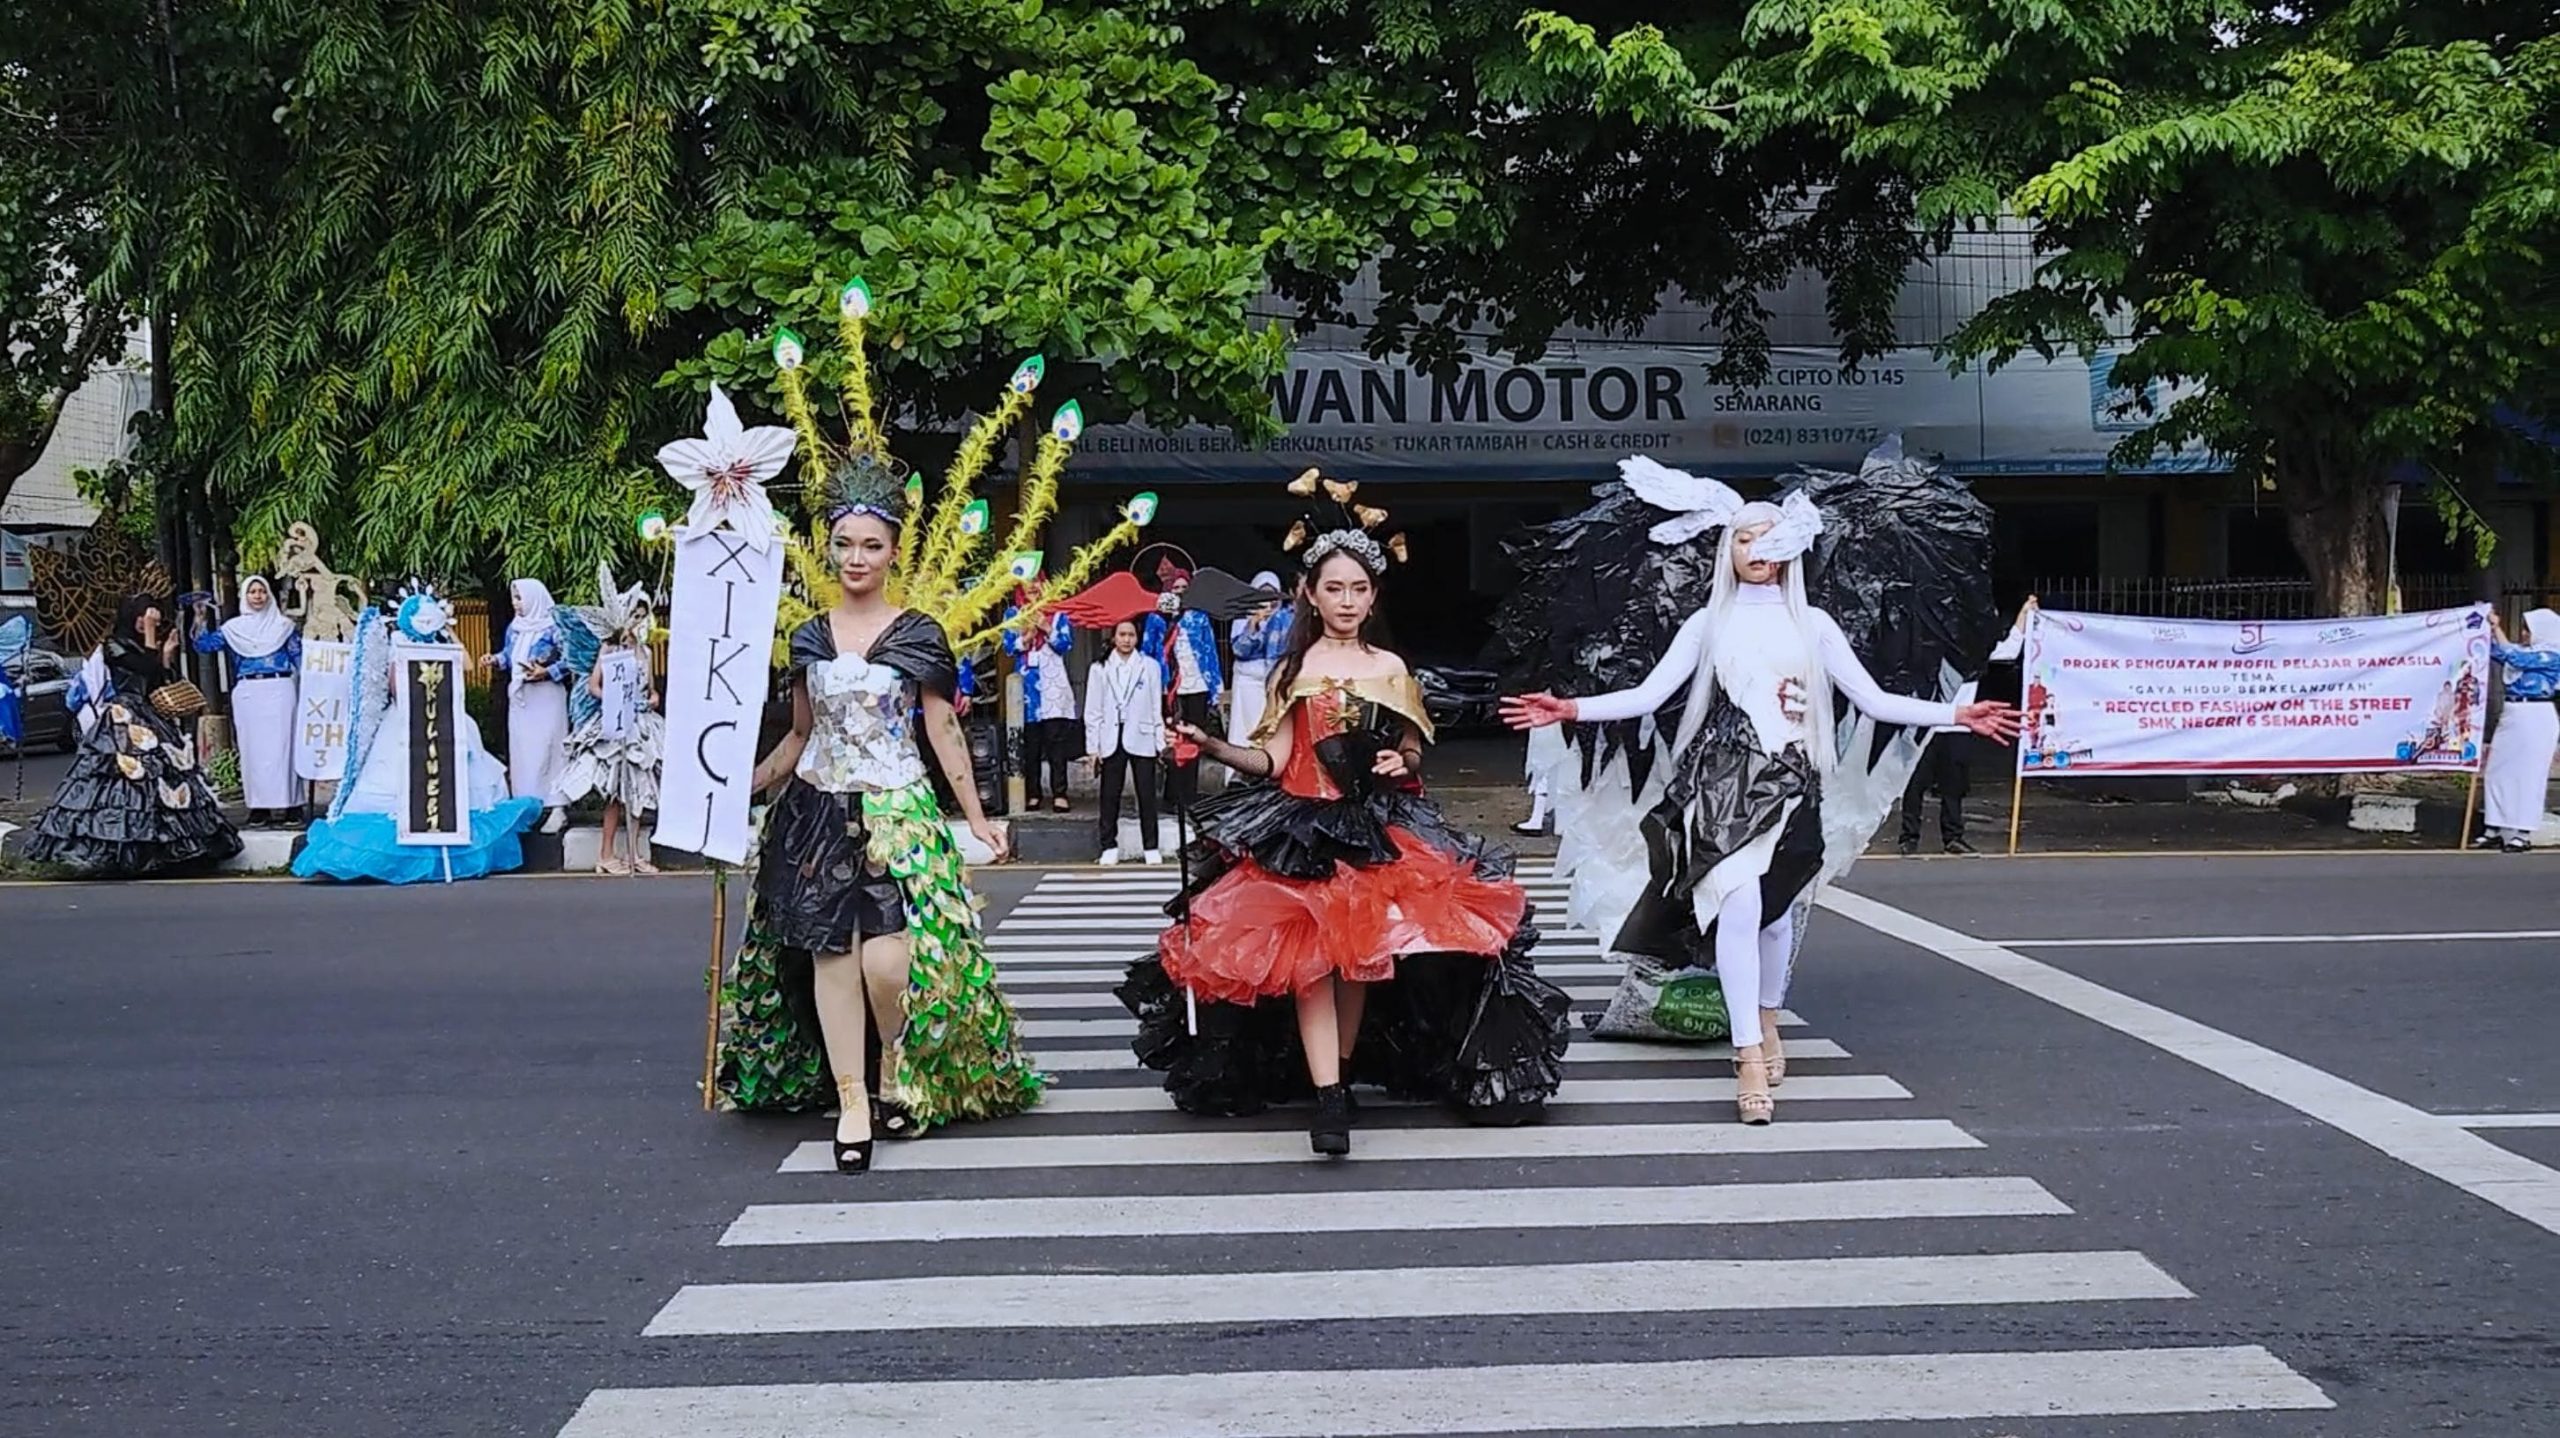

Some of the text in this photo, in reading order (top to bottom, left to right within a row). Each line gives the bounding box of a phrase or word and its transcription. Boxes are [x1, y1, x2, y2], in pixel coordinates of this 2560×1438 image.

[1777, 368, 1833, 386] CIPTO
[1837, 369, 1866, 386] NO
[1873, 369, 1905, 386] 145
[1265, 366, 1687, 424] WAN MOTOR
[1713, 395, 1822, 412] SEMARANG
[1094, 437, 1134, 453] BELI
[1143, 437, 1196, 453] MOBIL
[1265, 435, 1374, 452] ERKUALITAS
[1391, 435, 1450, 451] TUKAR
[1453, 435, 1527, 451] TAMBAH
[1543, 433, 1589, 450] CASH
[1592, 433, 1606, 450] &
[1610, 432, 1671, 449] CREDIT
[1743, 427, 1792, 446] (024)
[2062, 655, 2442, 669] PROJEK PENGUATAN PROFIL PELAJAR PANCASILA
[2230, 672, 2275, 682] TEMA
[2183, 684, 2231, 695] HIDUP
[306, 697, 341, 721] XI
[2105, 700, 2195, 713] RECYCLED
[2199, 700, 2277, 713] FASHION
[2280, 699, 2305, 711] ON
[2309, 698, 2344, 711] THE
[2349, 697, 2413, 711] STREET
[2138, 716, 2177, 730] SMK
[2182, 715, 2242, 729] NEGERI
[2246, 714, 2257, 727] 6
[2260, 713, 2360, 727] SEMARANG
[305, 723, 345, 747] PH
[313, 749, 328, 768] 3
